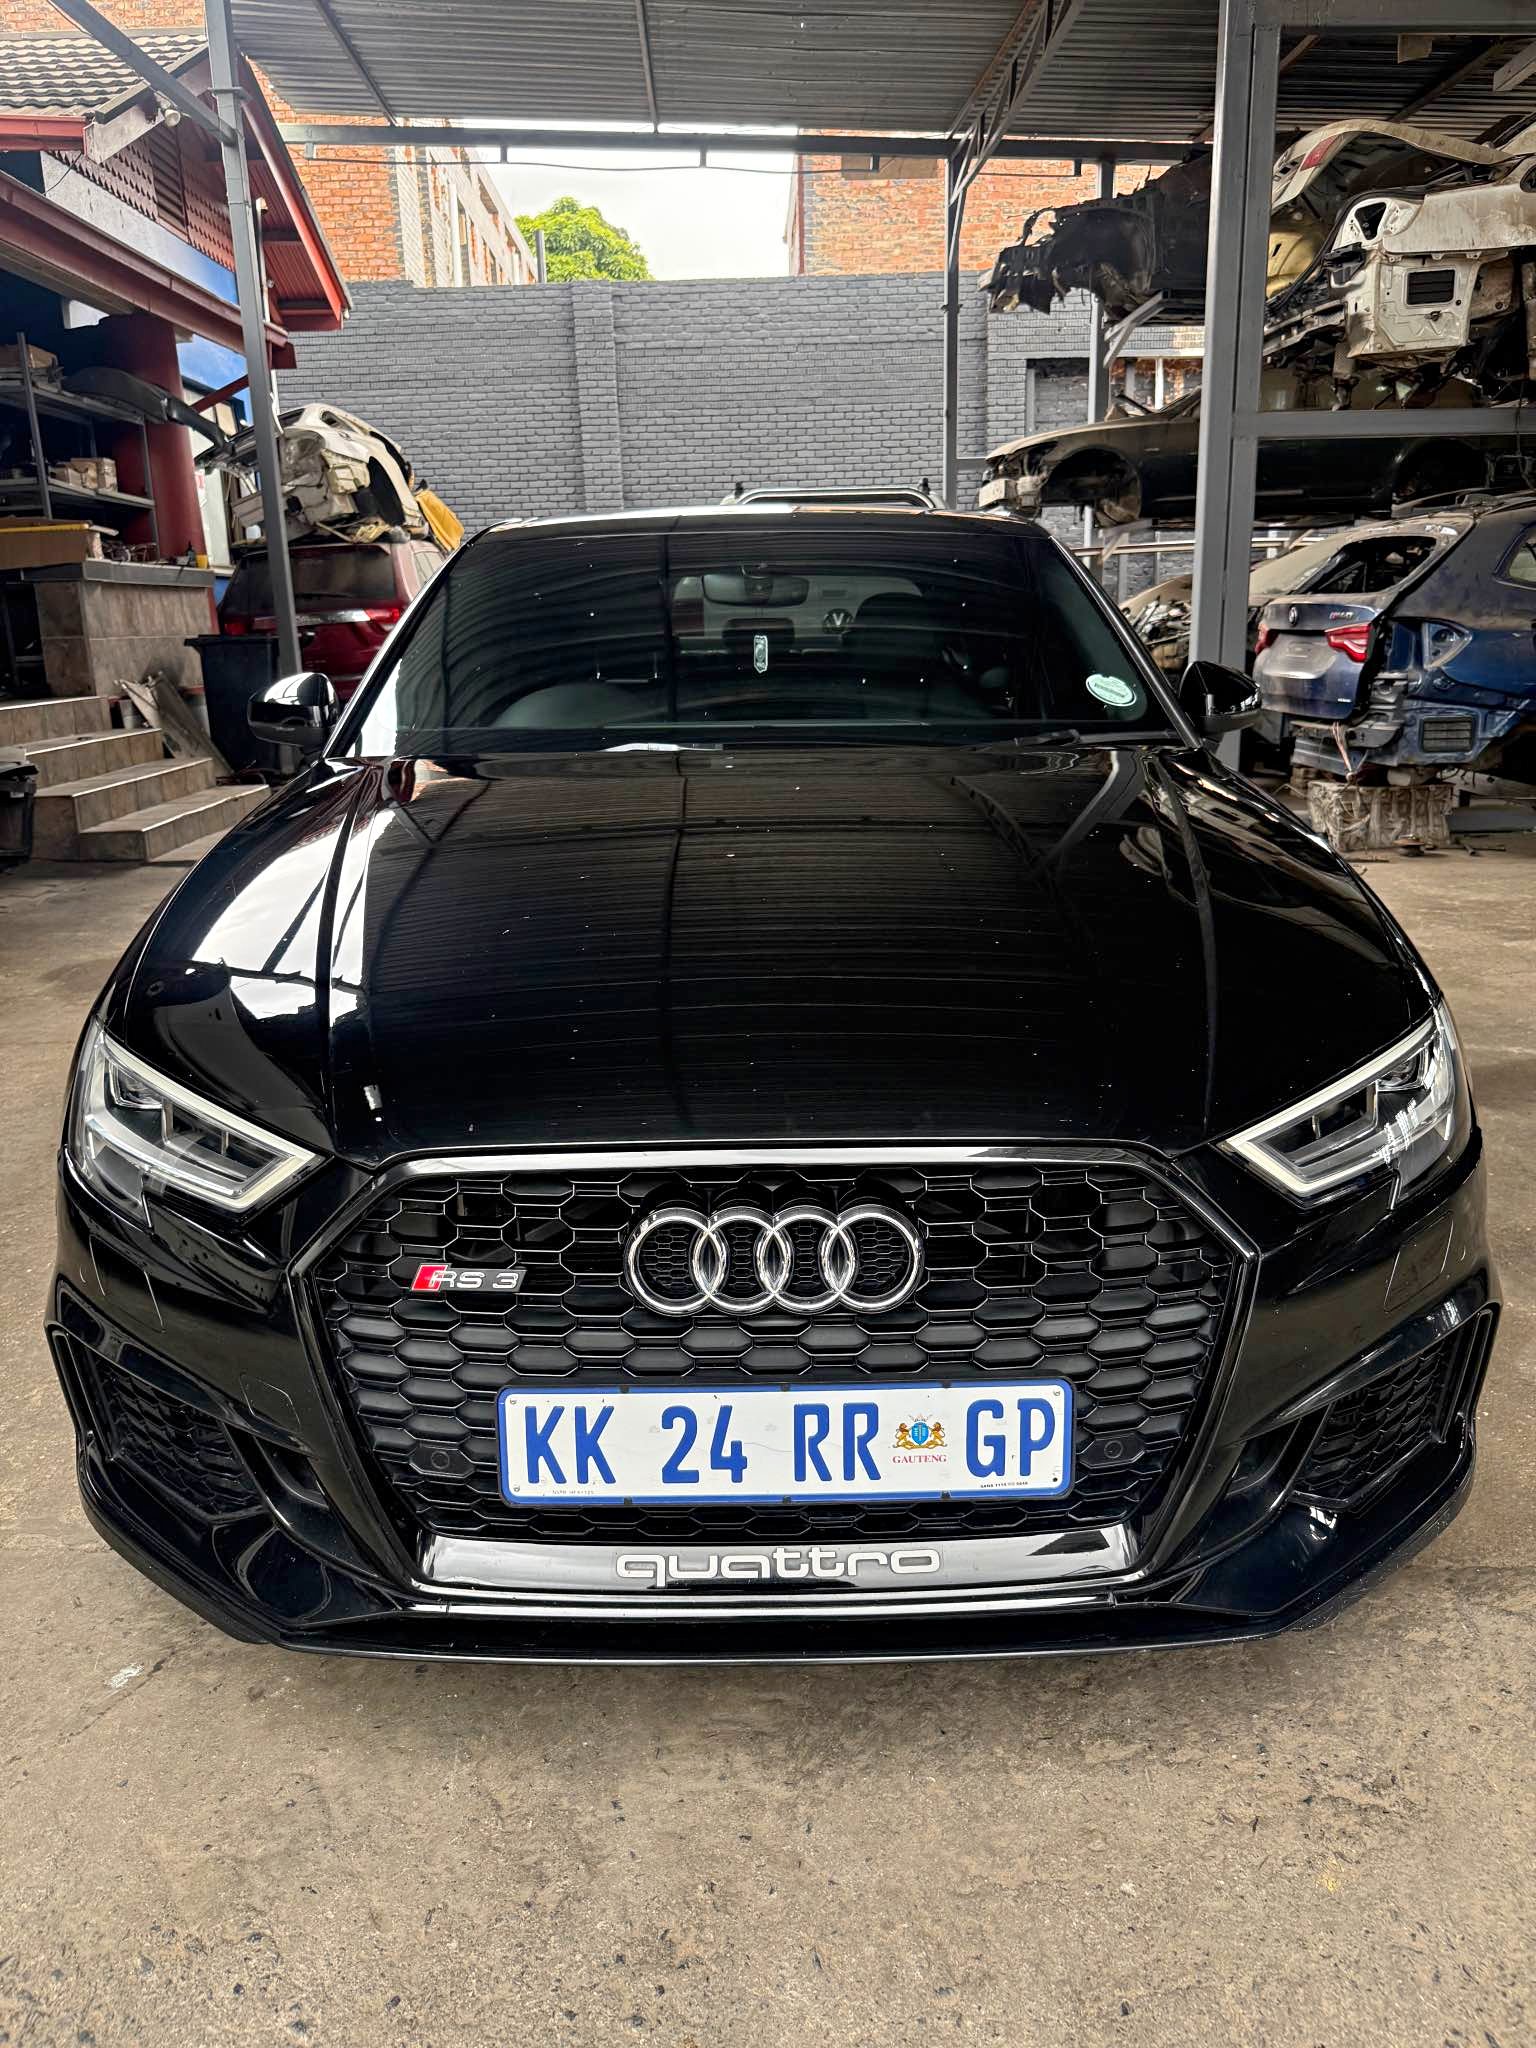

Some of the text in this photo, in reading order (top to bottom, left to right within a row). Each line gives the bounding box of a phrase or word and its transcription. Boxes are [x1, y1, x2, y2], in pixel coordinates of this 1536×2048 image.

[429, 1270, 519, 1288] RS 3
[524, 1398, 1056, 1484] KK 24 RR GP
[892, 1454, 947, 1464] GAUTENG
[616, 1547, 940, 1587] quattro
